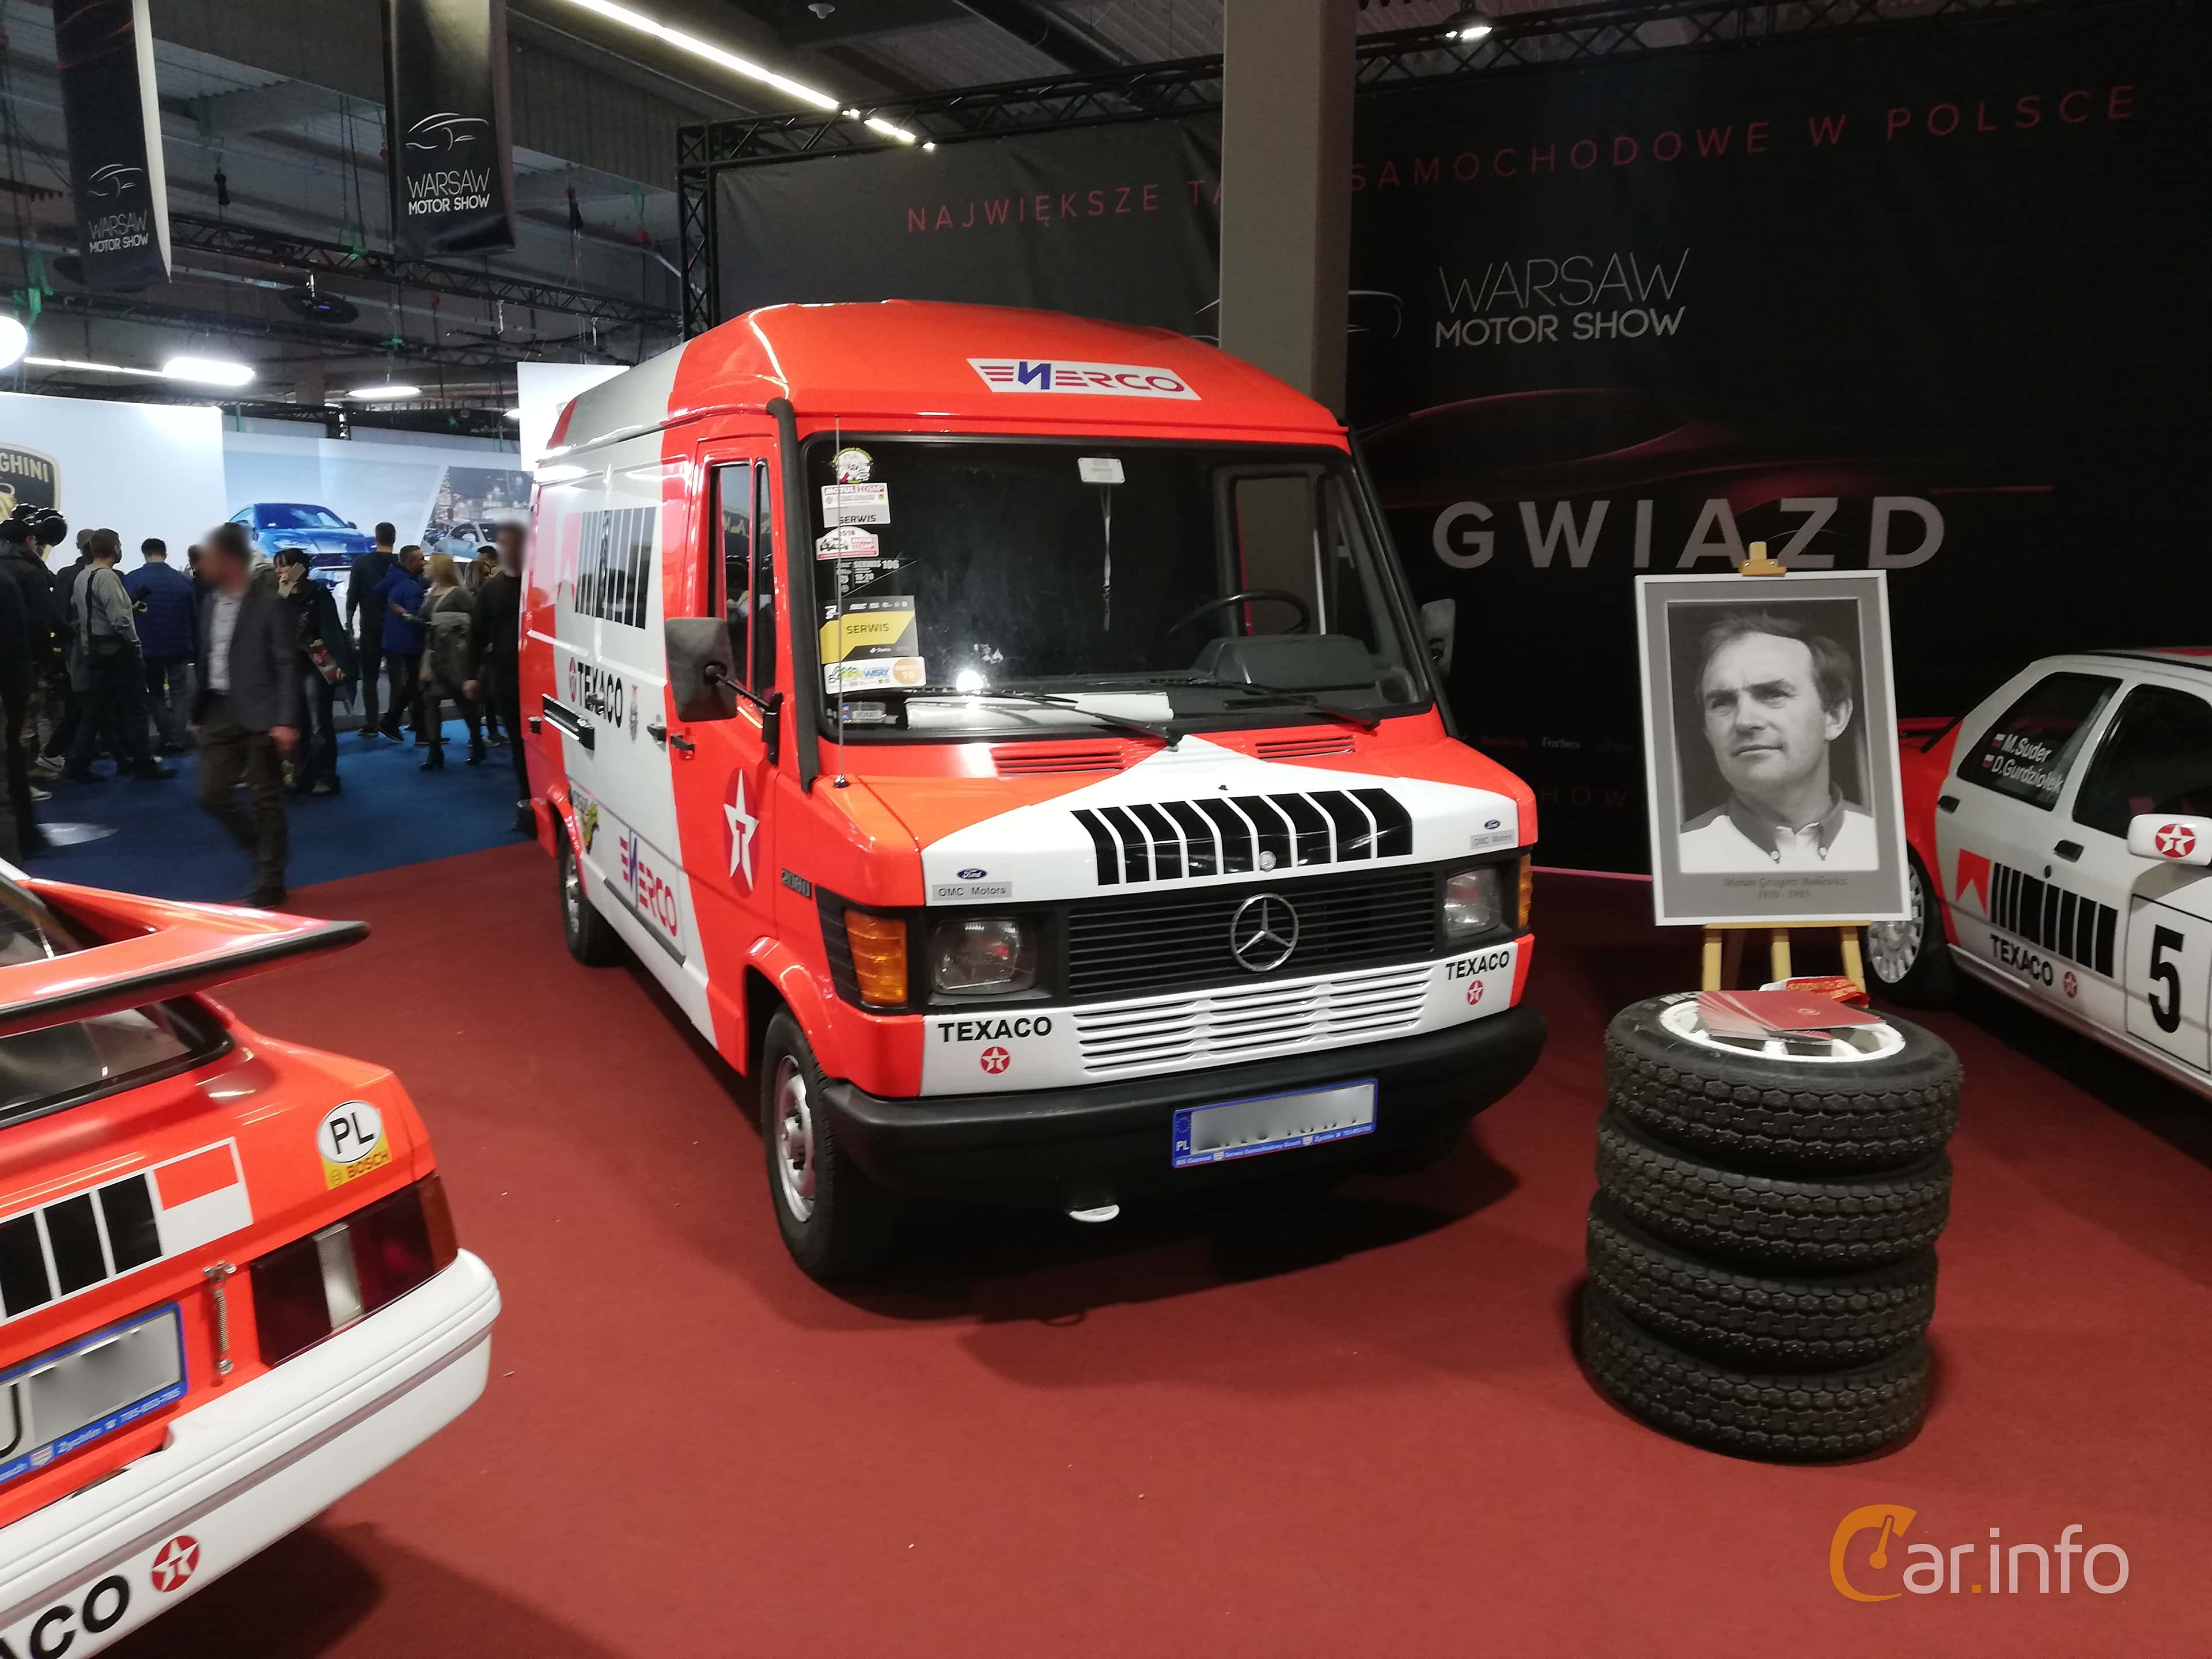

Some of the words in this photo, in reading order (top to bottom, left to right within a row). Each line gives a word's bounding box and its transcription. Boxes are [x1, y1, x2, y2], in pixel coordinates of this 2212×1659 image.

[908, 184, 1159, 232] NAJWIĘKSZE
[1350, 122, 1769, 193] SAMOCHODOWE
[1809, 113, 1849, 146] W
[1887, 85, 2134, 139] POLSCE
[407, 167, 490, 199] WARSAW
[408, 198, 450, 215] MOTOR
[453, 194, 490, 211] SHOW
[88, 209, 147, 240] WARSAW
[89, 237, 121, 253] MOTOR
[122, 232, 149, 249] SHOW
[1439, 248, 1690, 314] WARSAW
[1435, 314, 1559, 348] MOTOR
[1572, 306, 1685, 340] SHOW
[839, 515, 876, 525] SERWIS
[1431, 495, 1945, 569] GWIAZD
[846, 623, 890, 635] SERWIS
[578, 661, 623, 728] TEXACO
[1541, 736, 1581, 748] Forbes
[2001, 733, 2052, 763] M.Suder
[938, 887, 964, 897] OMC
[971, 886, 1007, 895] Motors
[1445, 950, 1509, 980] TEXACO
[1990, 933, 2053, 986] TEXACO
[2149, 924, 2184, 1033] 5
[937, 1016, 1052, 1043] TEXACO
[329, 1112, 375, 1155] PL
[1176, 1139, 1190, 1152] PL
[346, 1150, 389, 1179] BOSCH
